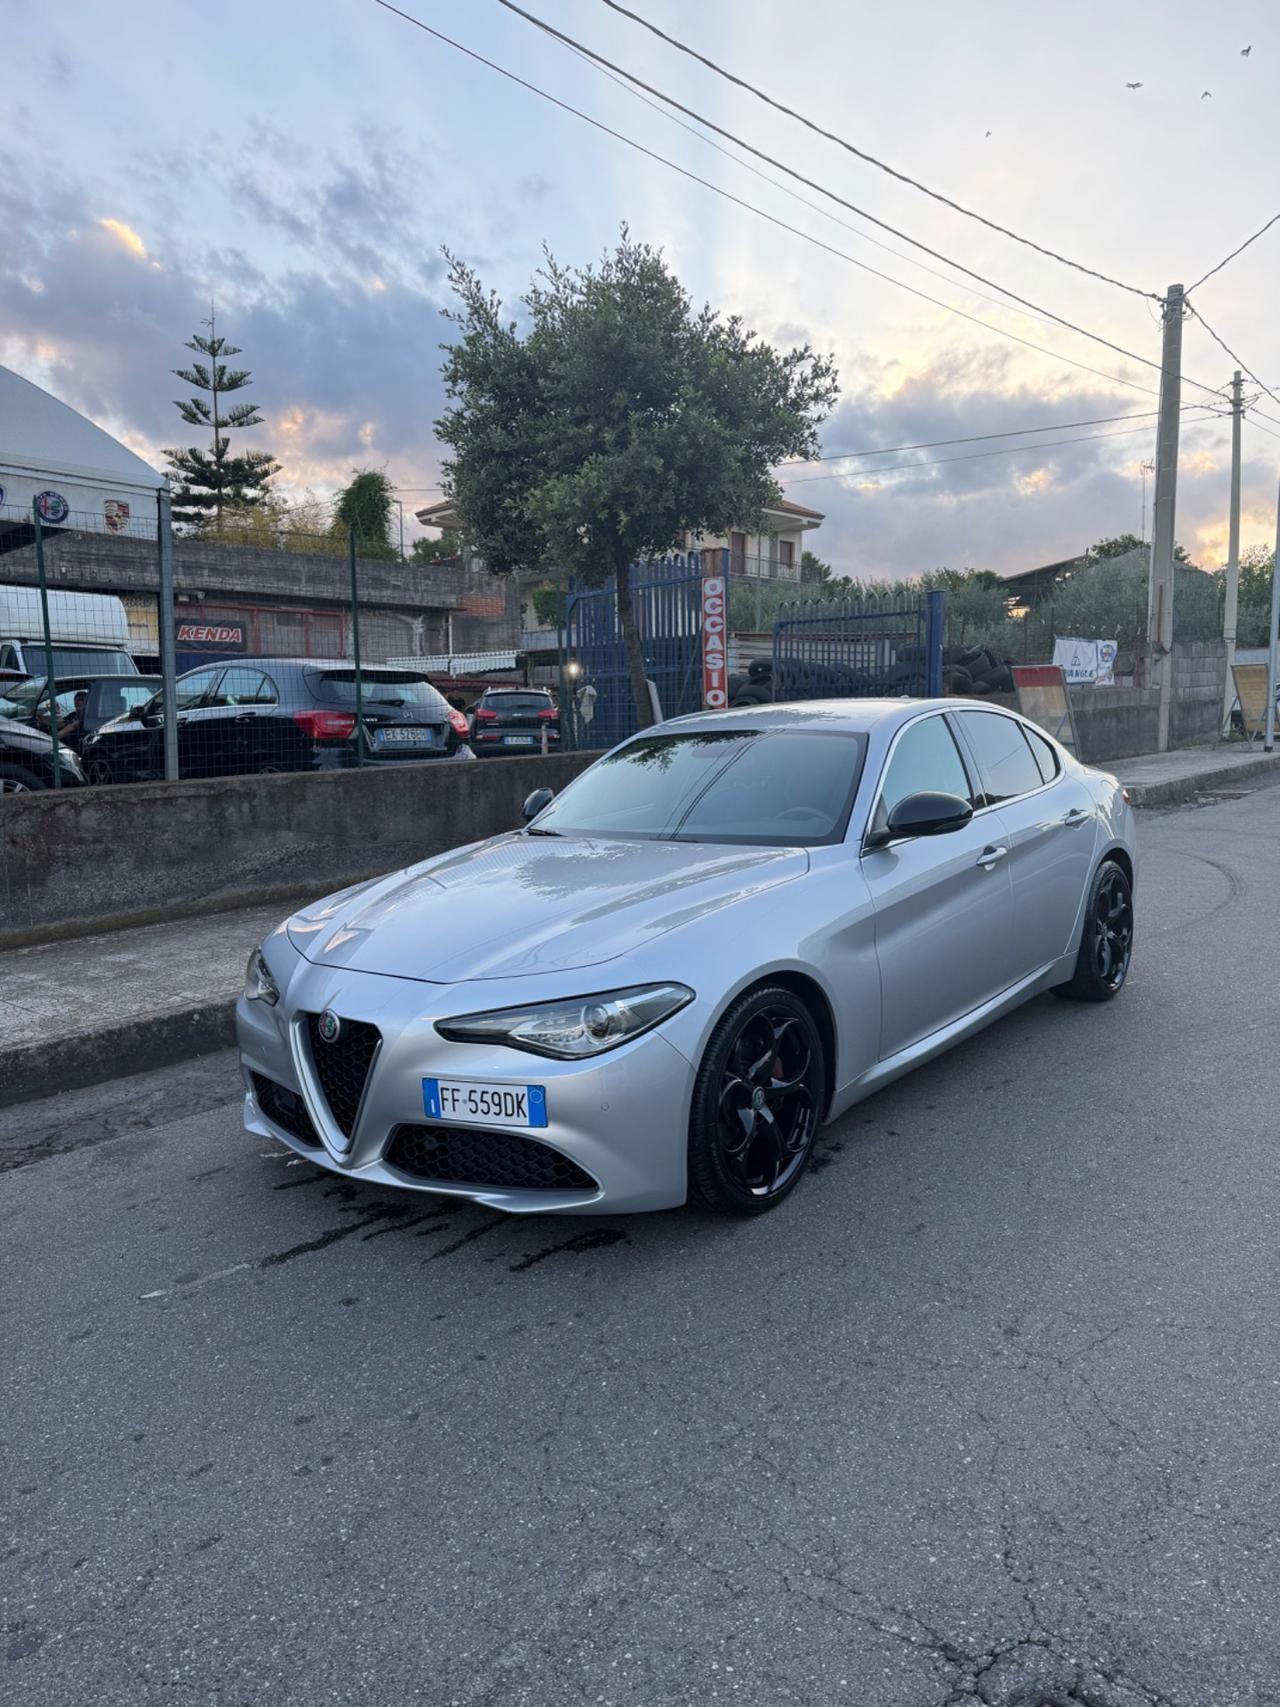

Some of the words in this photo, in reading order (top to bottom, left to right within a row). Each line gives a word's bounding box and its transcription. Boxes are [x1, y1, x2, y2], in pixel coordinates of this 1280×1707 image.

[177, 625, 242, 643] KENDA
[704, 579, 725, 706] OCCASIO
[440, 1087, 461, 1112] FF
[468, 1089, 527, 1118] 559DK
